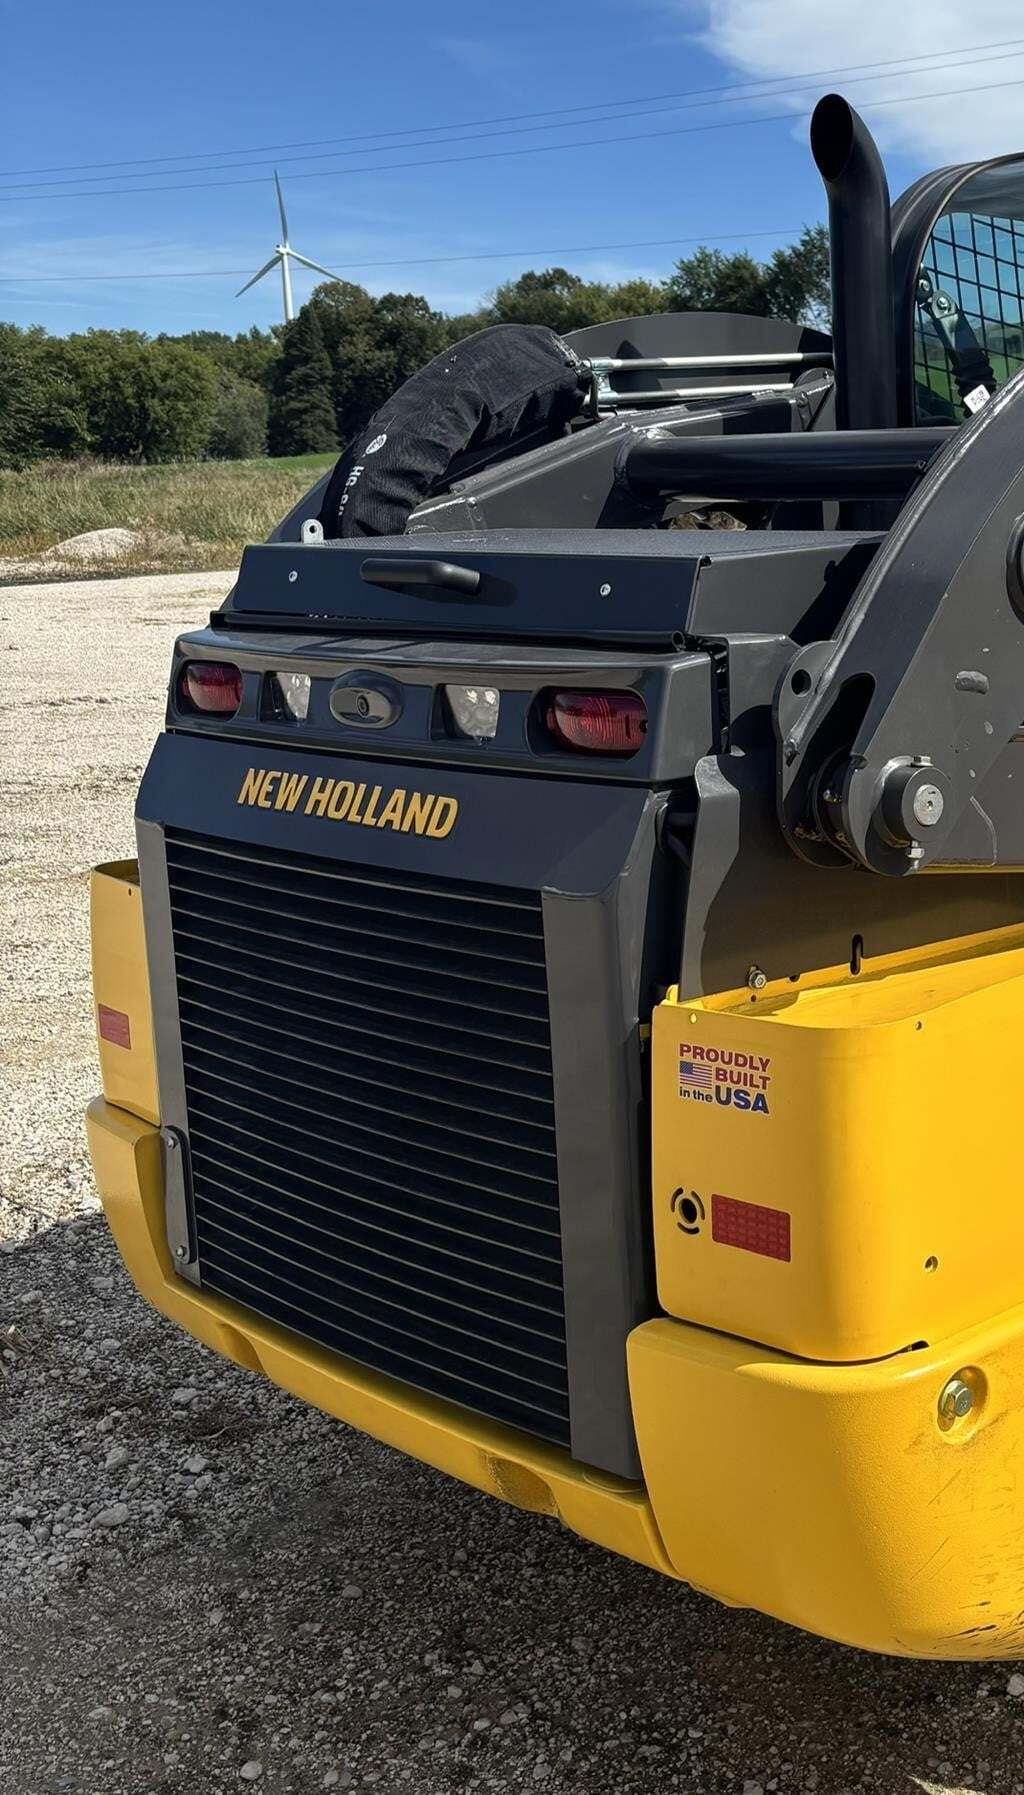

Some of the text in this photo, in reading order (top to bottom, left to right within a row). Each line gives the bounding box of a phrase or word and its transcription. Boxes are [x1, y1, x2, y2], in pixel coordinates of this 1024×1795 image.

[237, 768, 459, 839] NEW HOLLAND
[679, 1043, 771, 1073] PROUDLY
[715, 1066, 771, 1090] BUILT
[680, 1084, 770, 1115] in the USA
